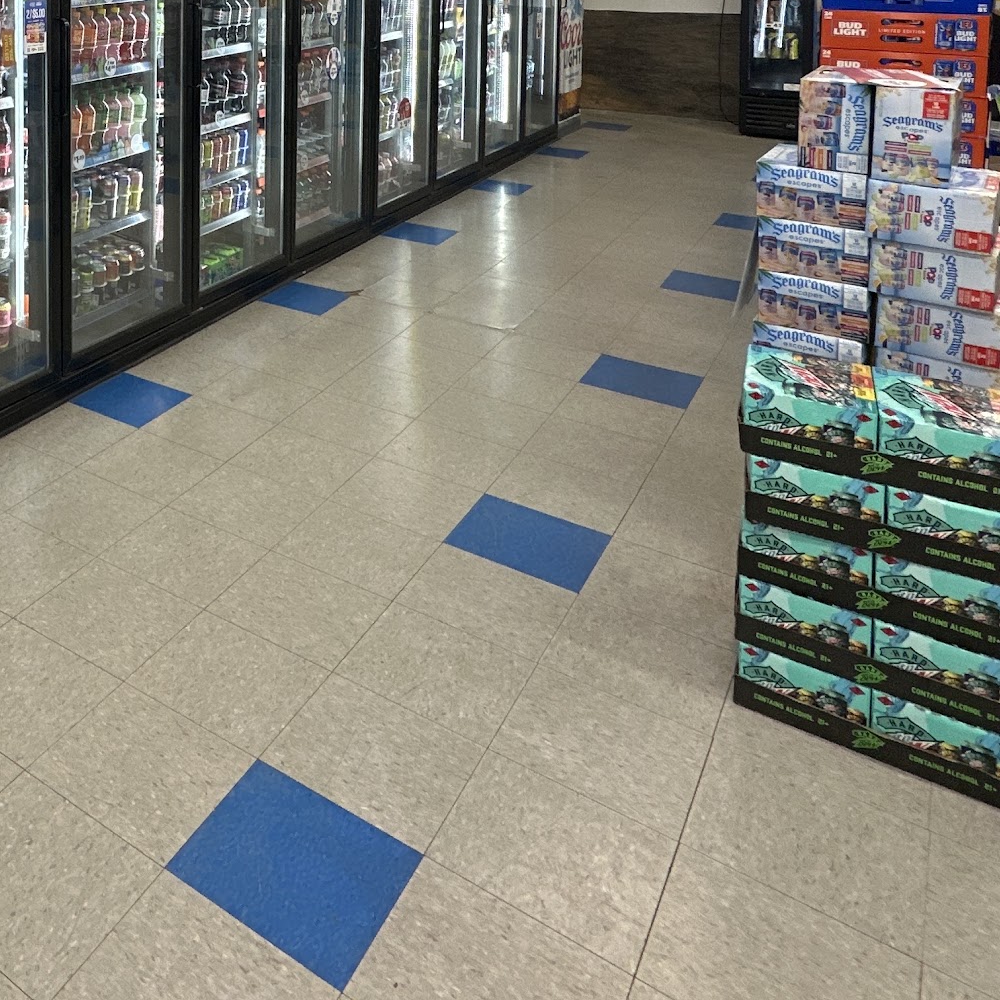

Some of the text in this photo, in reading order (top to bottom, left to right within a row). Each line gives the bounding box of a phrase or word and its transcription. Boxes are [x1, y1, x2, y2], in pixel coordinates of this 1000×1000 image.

[833, 28, 867, 36] LIGHT
[563, 47, 582, 68] LIGHT
[836, 60, 860, 69] BUD
[849, 94, 868, 152] Seagram's
[882, 117, 943, 133] Seagram's
[770, 168, 839, 188] Seagram's
[787, 180, 822, 189] escapes
[772, 221, 841, 244] Seagram's
[788, 233, 824, 244] escapes
[771, 275, 840, 299] Seagram's
[788, 288, 823, 300] escapes
[767, 329, 835, 353] Seagram's
[761, 437, 792, 449] CONTAINS
[917, 471, 953, 484] CONTAINS
[767, 506, 798, 520] CONTAINS
[925, 547, 960, 561] CONTAINS
[758, 561, 788, 577] CONTAINS
[913, 611, 948, 628] CONTAINS
[756, 632, 787, 648] CONTAINS
[911, 686, 947, 705] CONTAINS
